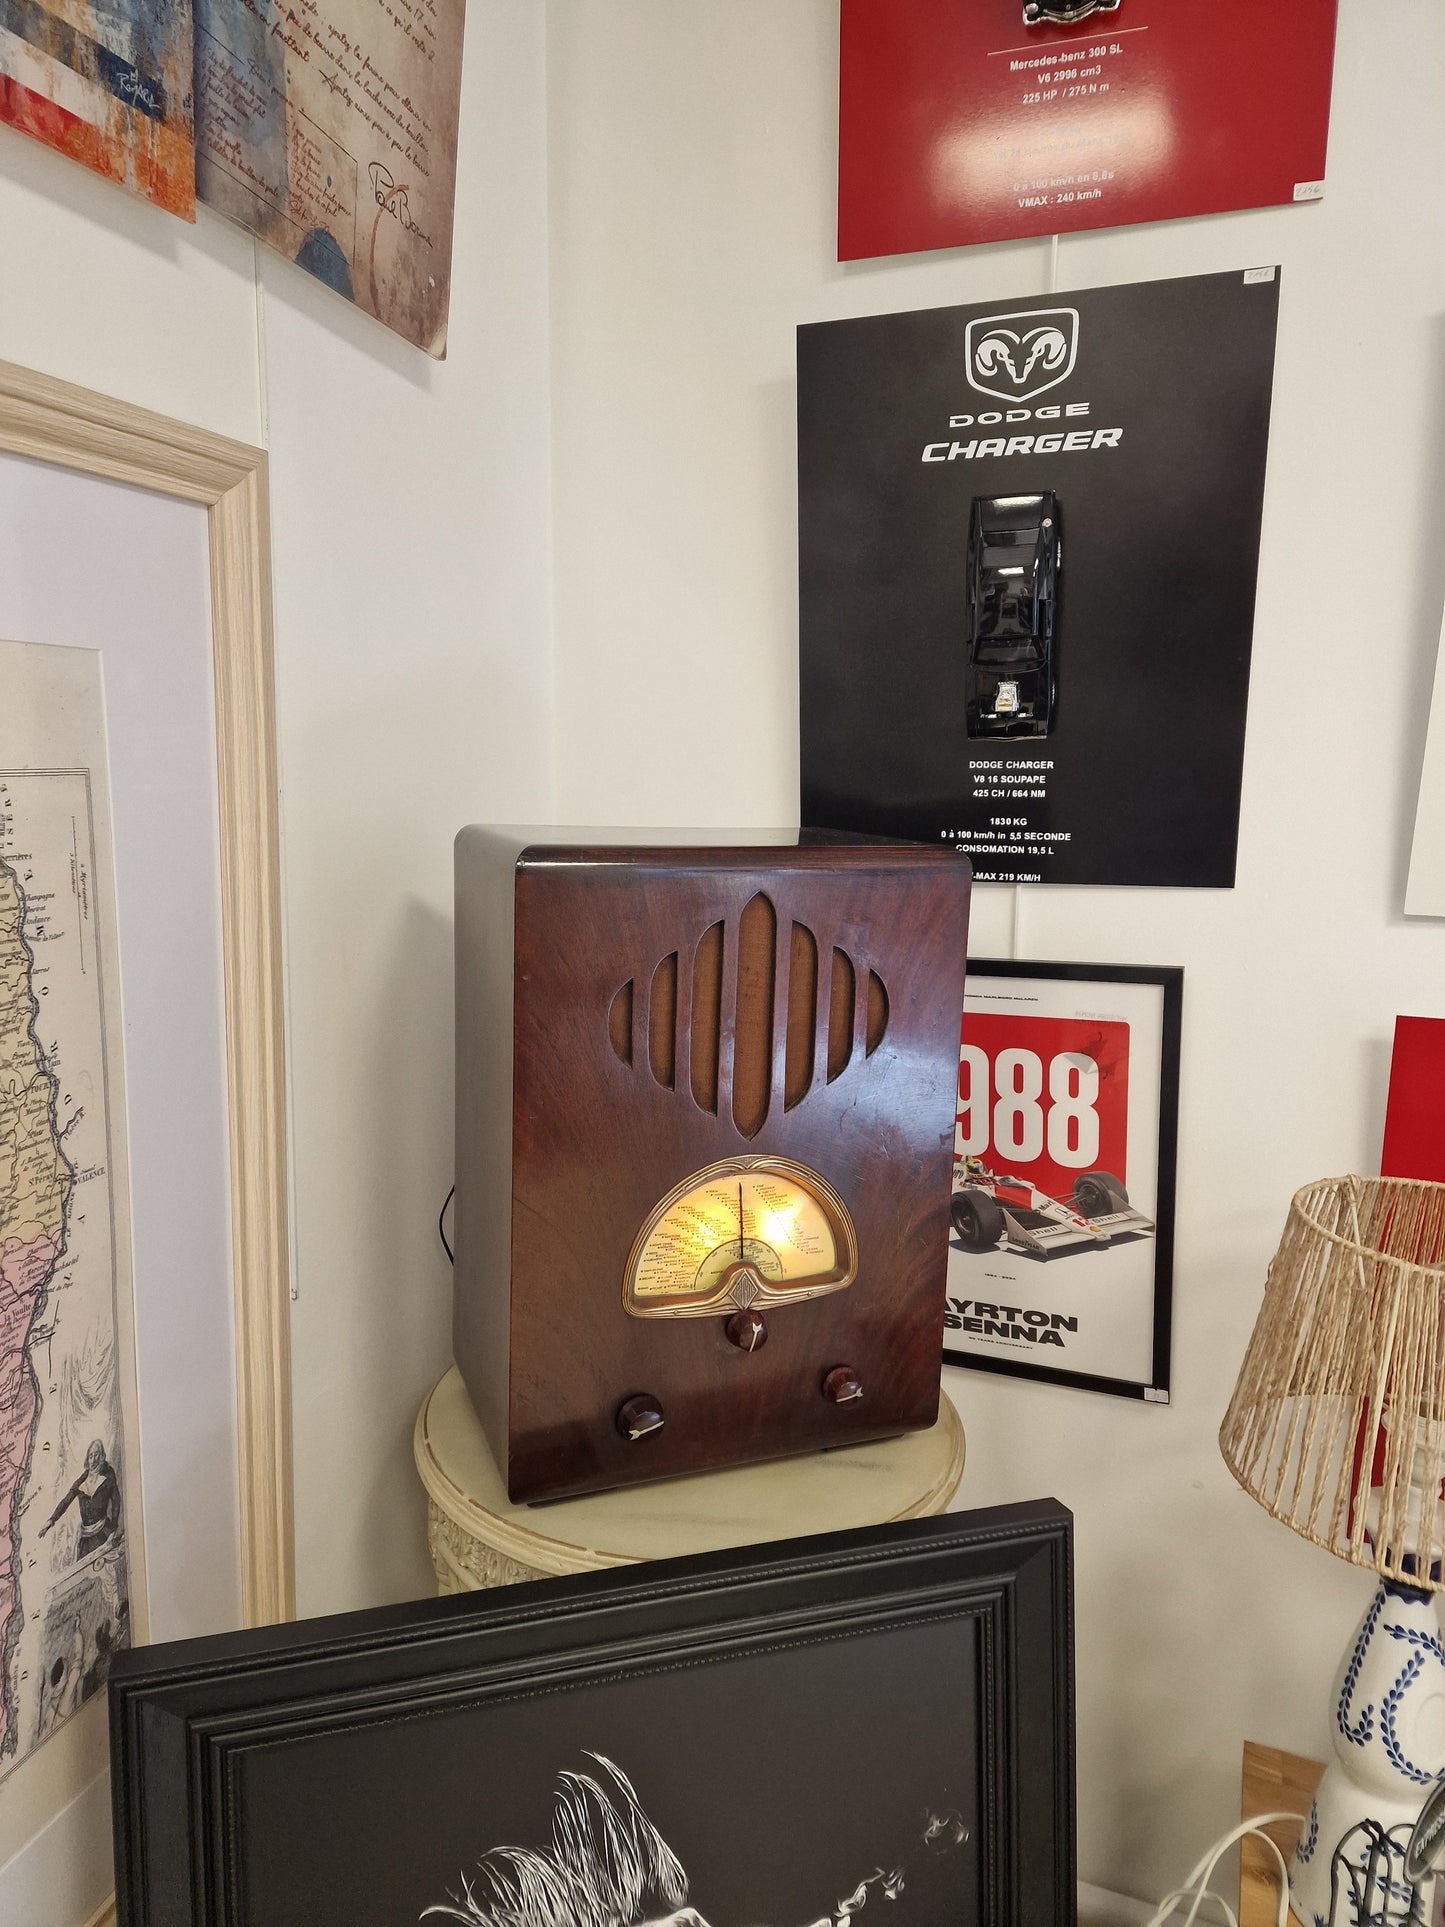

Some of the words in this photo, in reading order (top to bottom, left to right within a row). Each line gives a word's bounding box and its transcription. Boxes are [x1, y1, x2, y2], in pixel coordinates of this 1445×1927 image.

[1009, 49, 1086, 72] Mercedes-benz
[1088, 45, 1107, 59] 300
[1109, 43, 1123, 55] SL
[1037, 72, 1051, 84] V6
[1080, 64, 1102, 78] cm3
[1022, 91, 1041, 104] 225
[1042, 89, 1058, 101] HP
[1068, 85, 1087, 97] 275
[1089, 83, 1097, 94] N
[1099, 82, 1110, 92] m
[367, 161, 398, 219] Paul
[1031, 178, 1048, 190] 100
[1050, 175, 1075, 187] km/h
[1018, 195, 1048, 208] VMAX
[1056, 192, 1075, 204] 240
[1076, 188, 1102, 201] km/h
[949, 402, 1090, 428] DODGE
[921, 428, 1124, 463] CHARGER
[969, 760, 1003, 769] DODGE
[1005, 760, 1055, 770] CHARGER
[973, 775, 985, 784] V8
[988, 775, 998, 784] 16
[1000, 775, 1046, 784] SOUPAPE
[973, 789, 989, 797] 425
[991, 789, 1005, 798] CH
[1012, 789, 1028, 798] 664
[1030, 790, 1046, 798] NM
[990, 817, 1012, 826] 1830
[1013, 817, 1028, 826] KG
[941, 830, 947, 839] 0
[957, 831, 972, 839] 100
[973, 831, 996, 840] km/h
[997, 831, 1006, 840] in
[1009, 832, 1022, 842] 5,5
[1024, 832, 1072, 841] SECONDE
[955, 844, 1025, 854] CONSOMATION
[1027, 846, 1046, 856] 19,5
[1048, 846, 1055, 855] L
[971, 872, 997, 881] -MAX
[998, 873, 1015, 881] 219
[1016, 873, 1042, 882] KM/H
[953, 1043, 1100, 1169] 988
[1027, 1225, 1059, 1238] Shell
[944, 1312, 1065, 1348] SENNA
